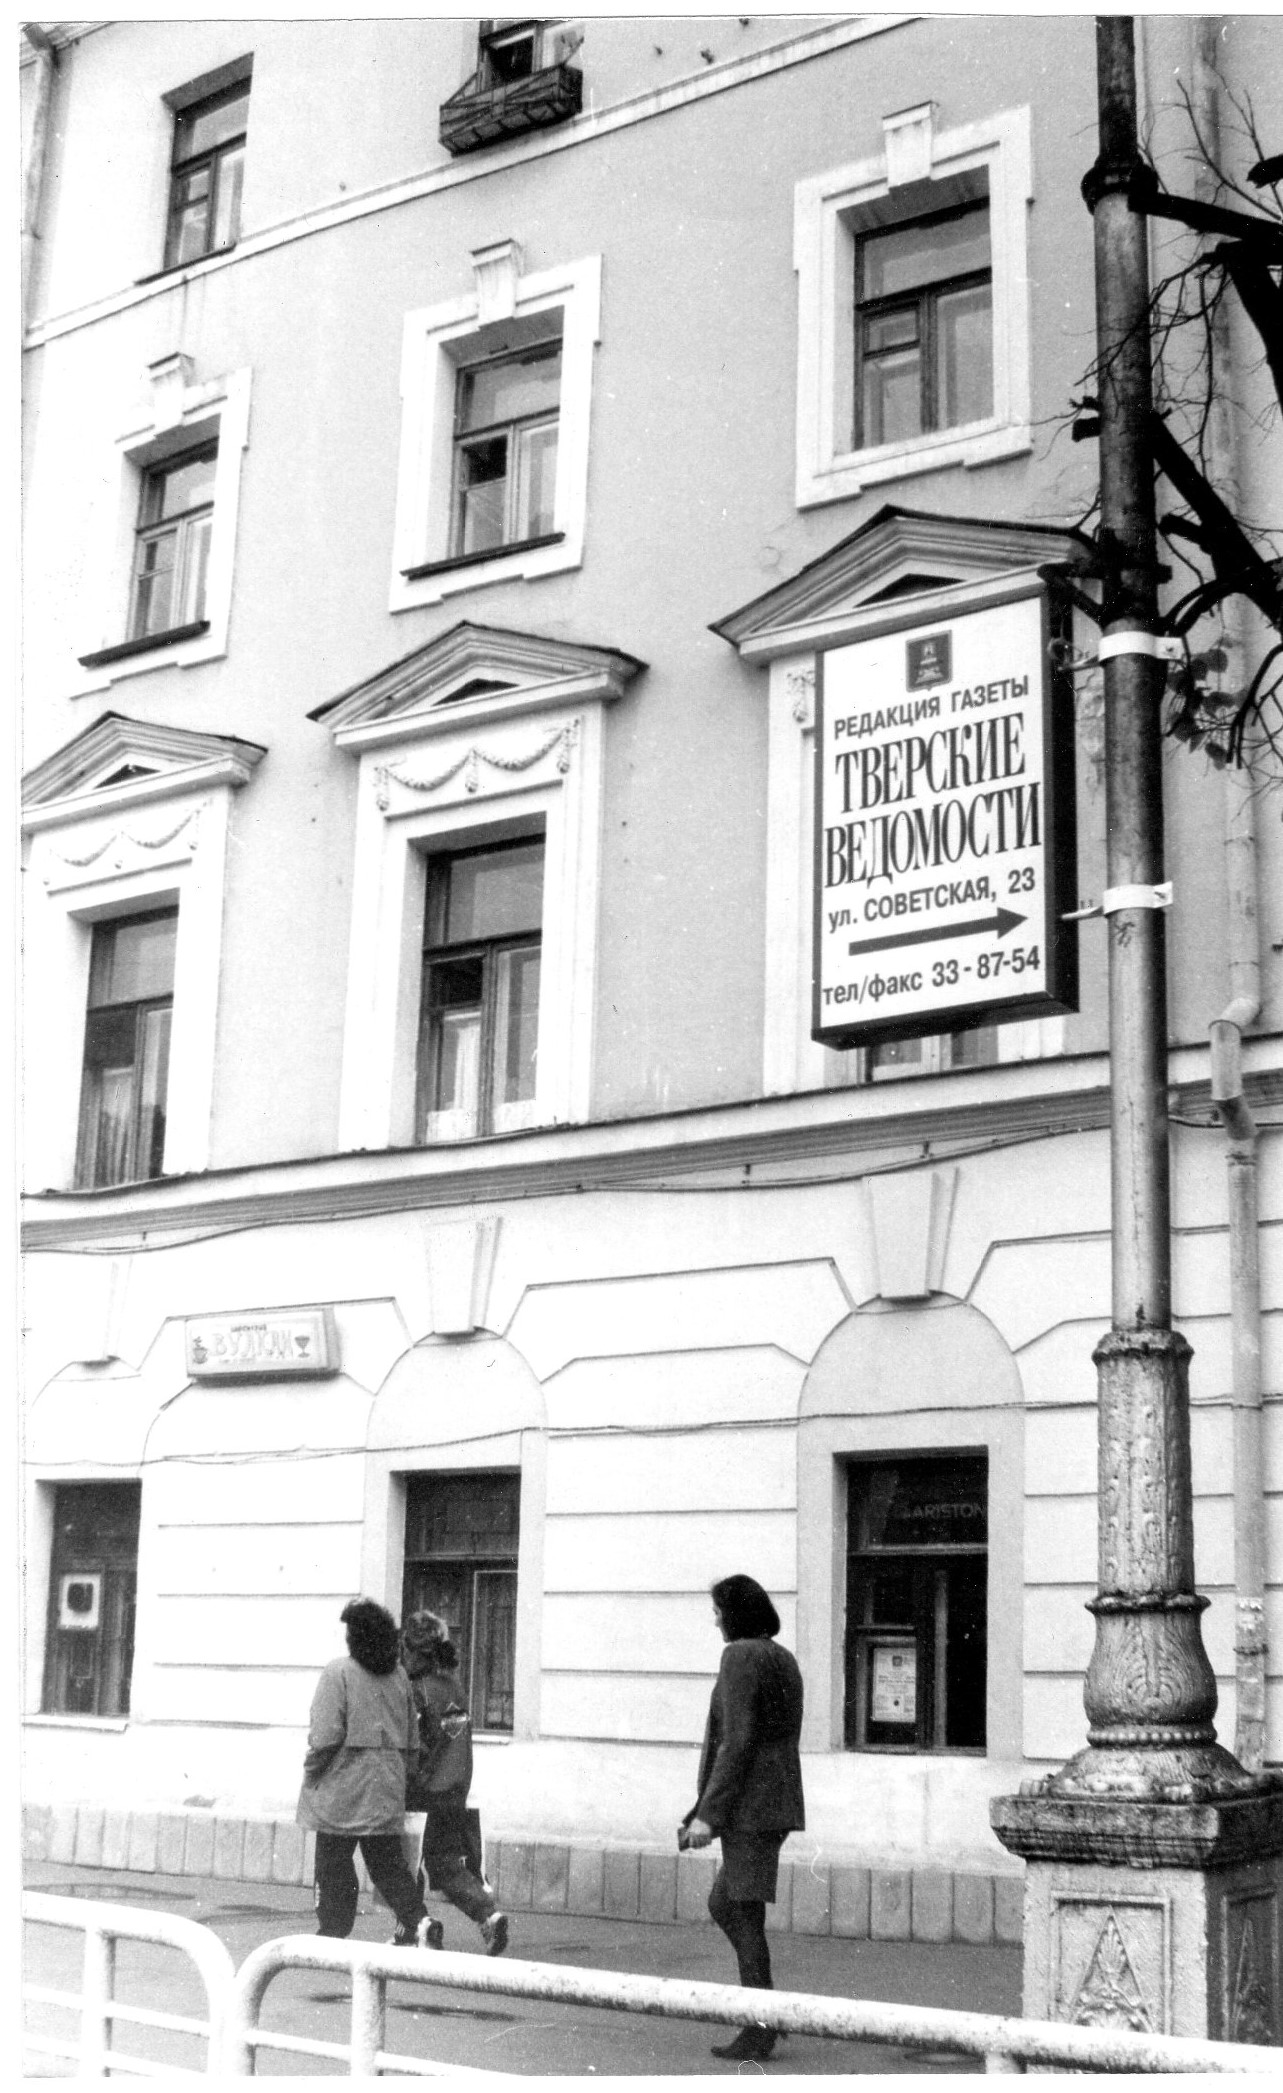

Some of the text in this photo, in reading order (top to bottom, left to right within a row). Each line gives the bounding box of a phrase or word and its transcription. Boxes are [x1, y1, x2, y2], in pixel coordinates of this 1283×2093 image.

[834, 675, 1029, 740] РЕДАКЦИЯ ГАЗЕТЫ
[835, 712, 1026, 814] ТВЕРСКИЕ
[824, 782, 1042, 889] ВЕДОМОСТИ
[828, 866, 1036, 934] ул. СОВЕТСКАЯ, 23
[822, 970, 923, 1004] тел/факс
